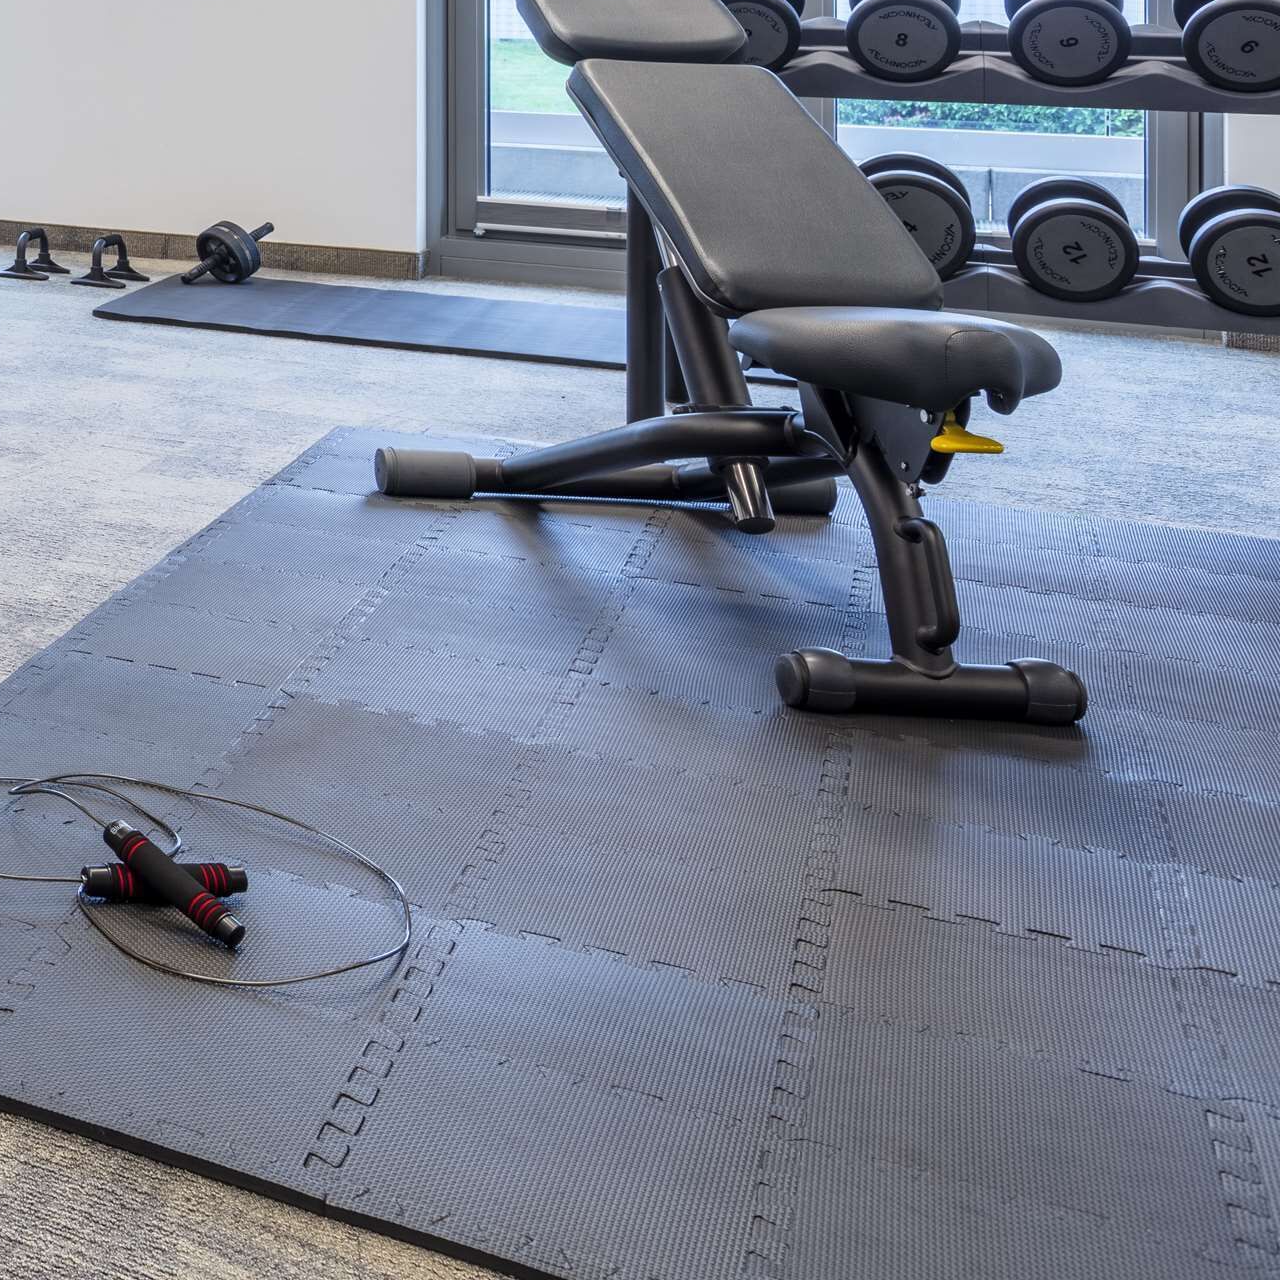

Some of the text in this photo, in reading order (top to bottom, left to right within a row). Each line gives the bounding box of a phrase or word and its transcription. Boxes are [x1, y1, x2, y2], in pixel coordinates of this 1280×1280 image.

[895, 32, 908, 47] 8
[1062, 241, 1088, 265] 12
[1246, 253, 1273, 278] 12
